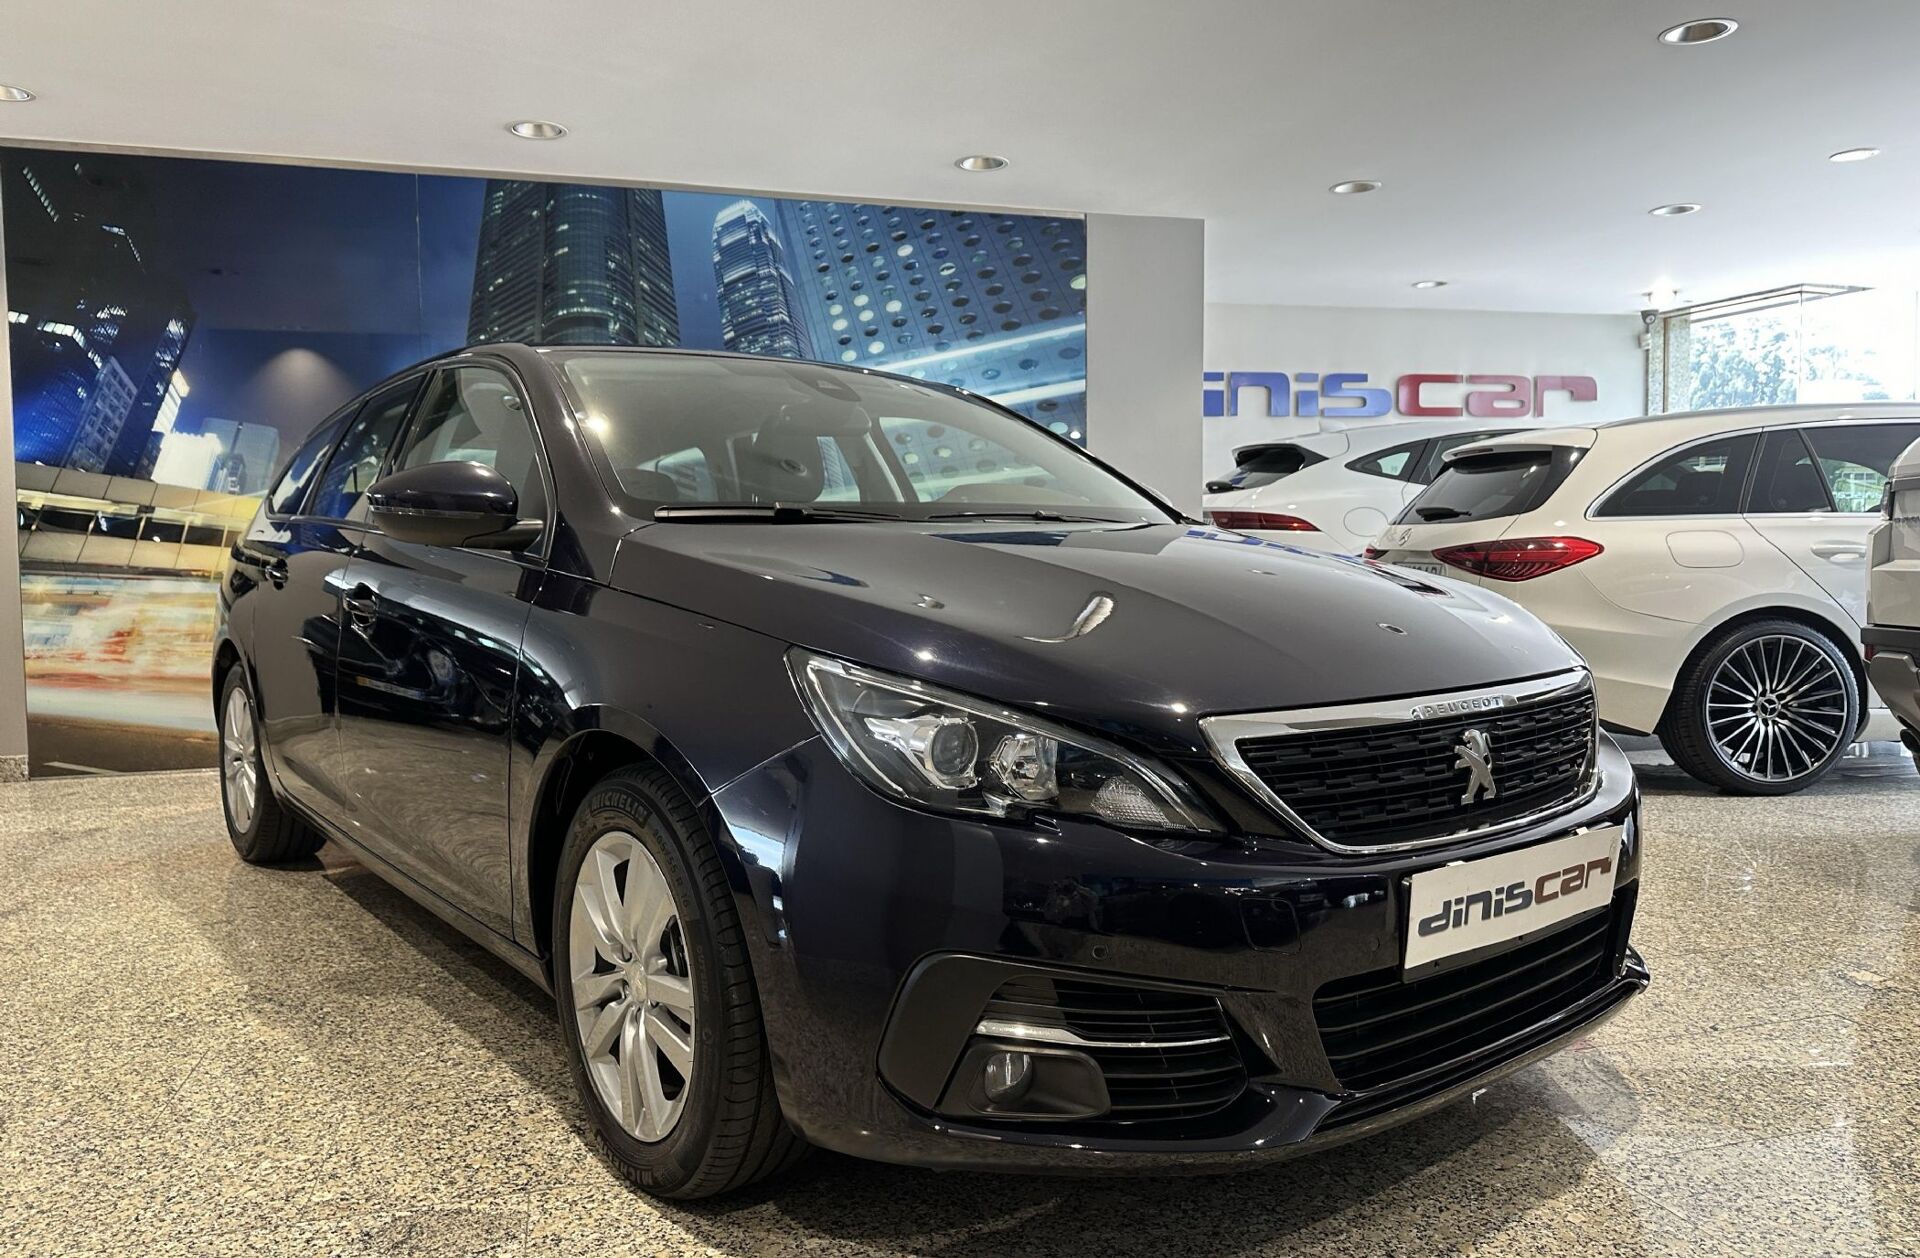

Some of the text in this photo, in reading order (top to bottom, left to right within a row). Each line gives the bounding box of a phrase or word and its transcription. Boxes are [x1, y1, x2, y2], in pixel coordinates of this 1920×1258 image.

[1203, 372, 1597, 417] iniscar
[1423, 695, 1501, 717] PEUGEOT
[591, 791, 648, 823] MICHELIN
